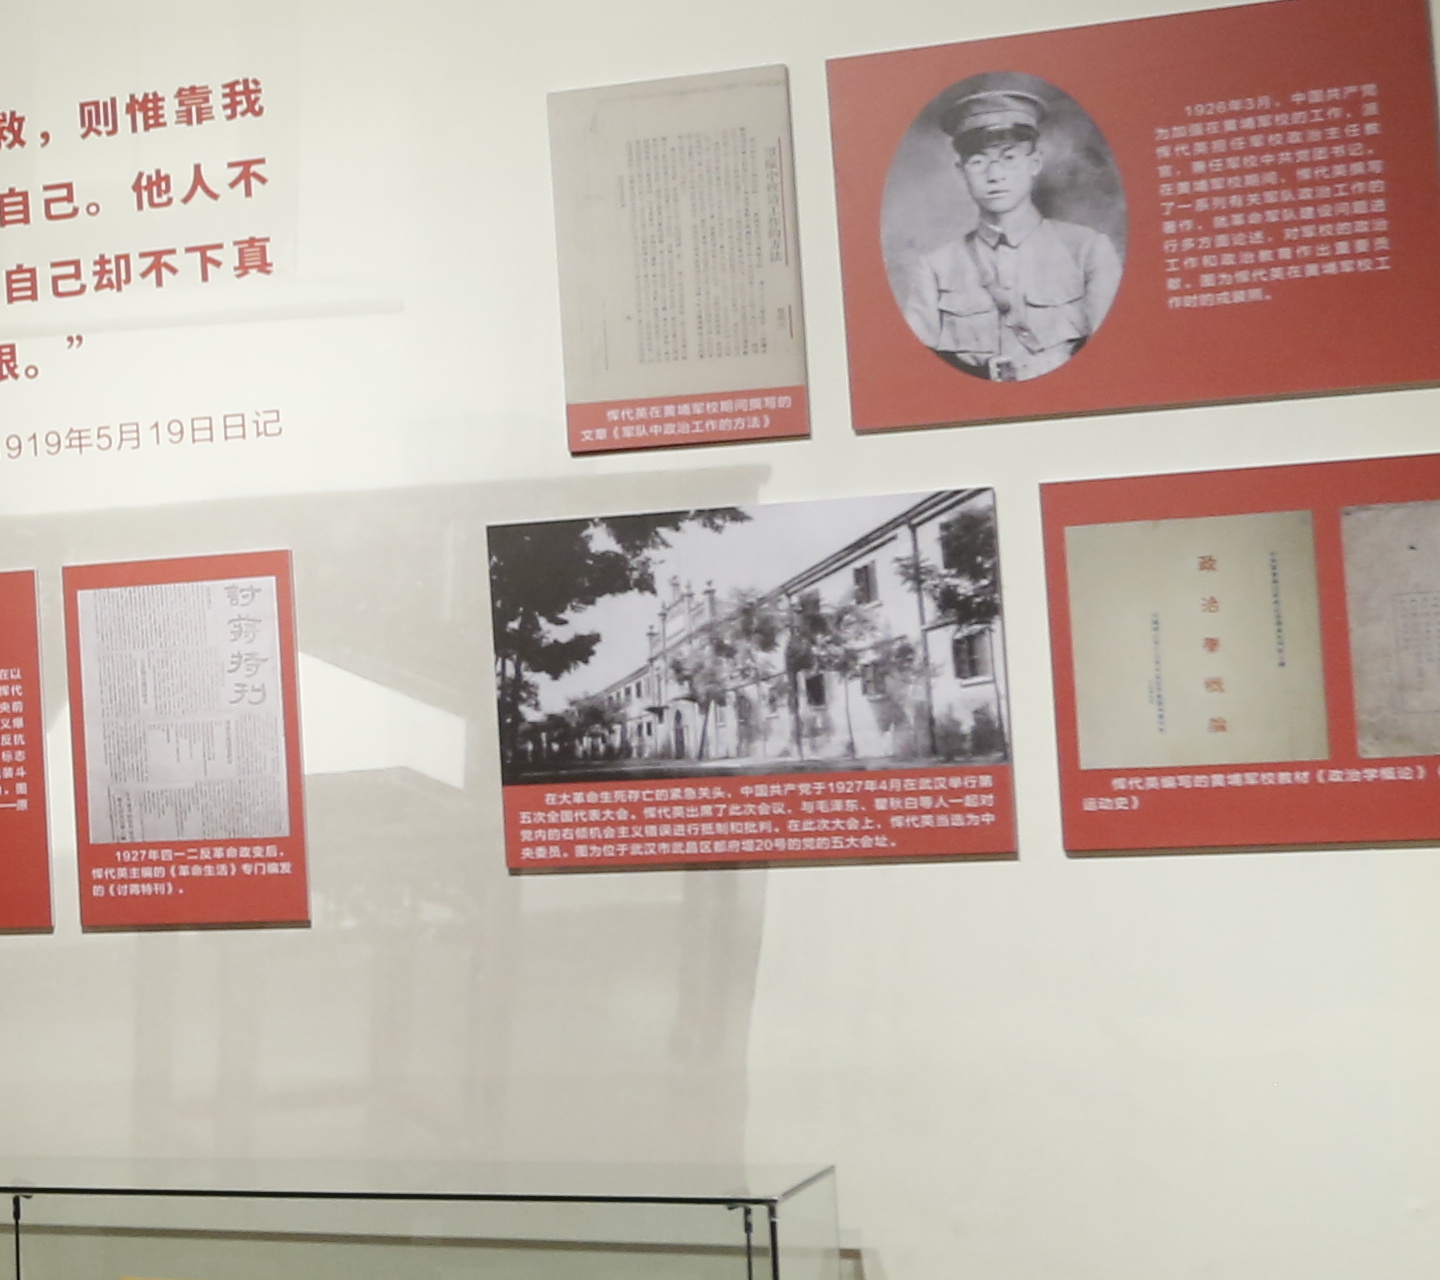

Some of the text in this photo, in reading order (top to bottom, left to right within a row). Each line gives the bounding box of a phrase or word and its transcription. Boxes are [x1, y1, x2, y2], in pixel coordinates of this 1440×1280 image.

[580, 415, 771, 442] 文章《军队中政治工作的方法》
[1111, 764, 1440, 791] 恽代英编写的黄埔军校教材《政治学概论》
